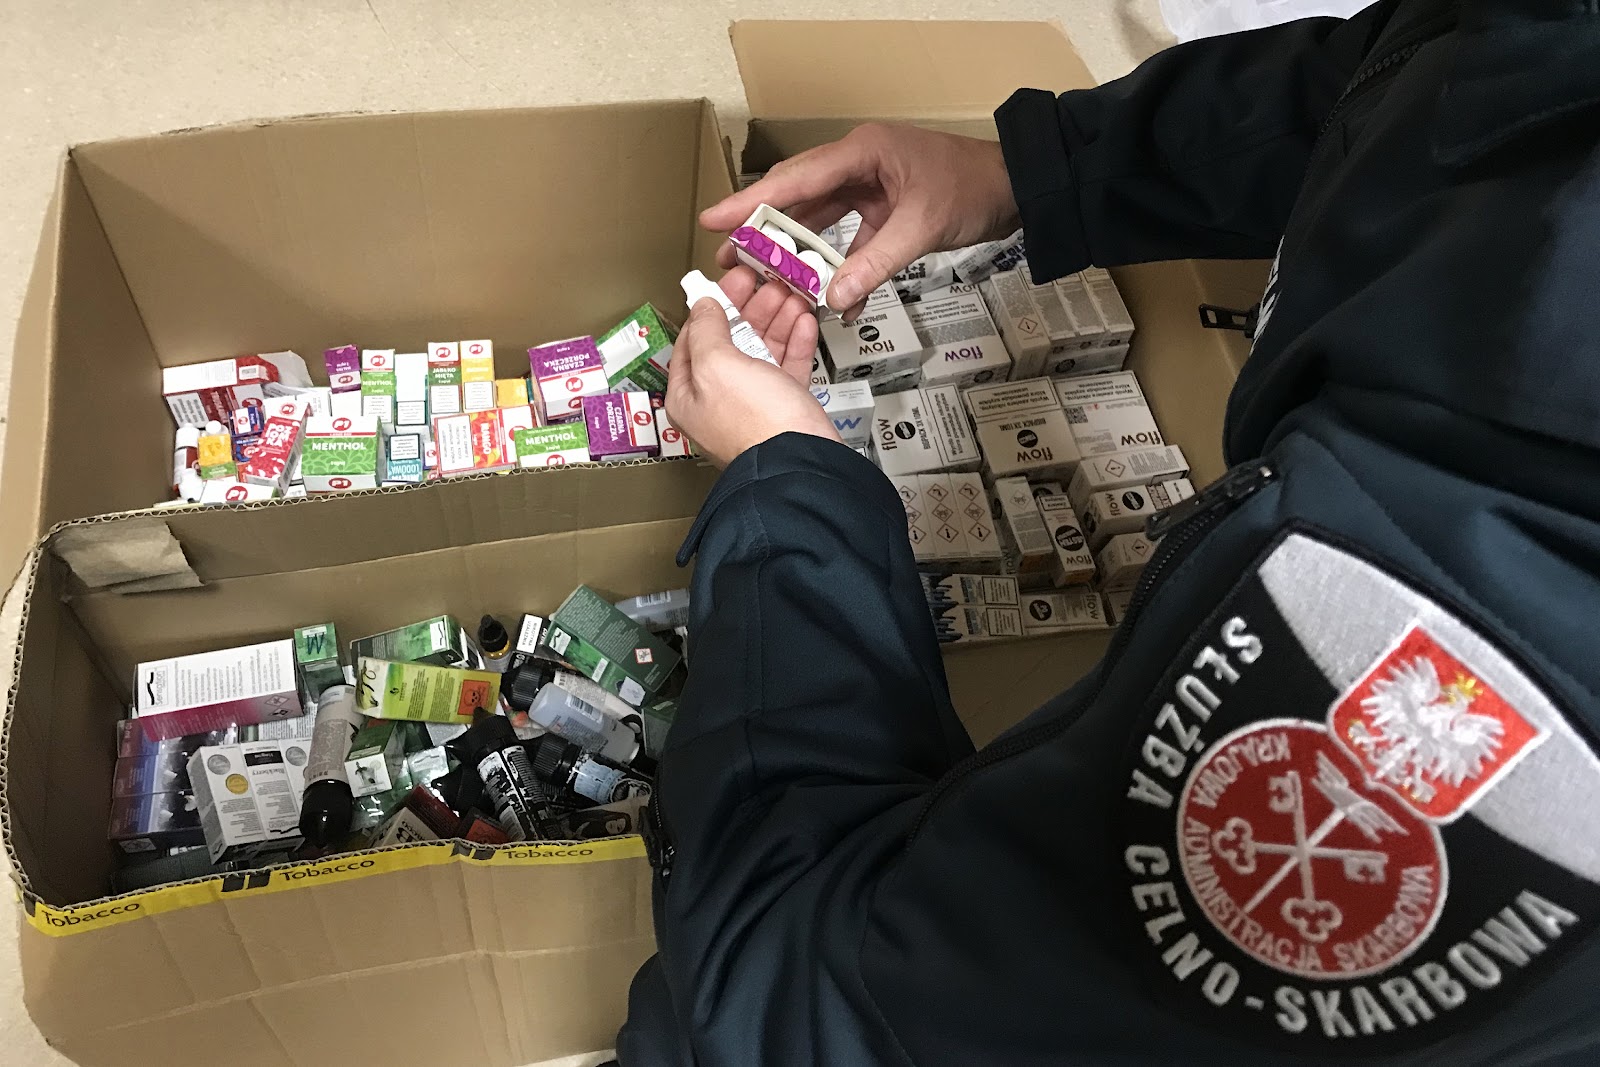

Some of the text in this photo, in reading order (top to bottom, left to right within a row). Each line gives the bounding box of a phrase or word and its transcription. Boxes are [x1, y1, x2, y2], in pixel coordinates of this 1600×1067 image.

[859, 339, 895, 356] flow
[945, 346, 984, 362] flow
[543, 352, 590, 367] PORZECZKA
[553, 360, 584, 372] CZARNA
[639, 370, 665, 391] MENTHO
[605, 401, 618, 441] PORZECZKA
[614, 406, 625, 434] CZARNA
[481, 423, 491, 455] MANGO
[525, 431, 578, 446] MENTHOL
[878, 418, 897, 451] flow
[1121, 431, 1161, 446] flow
[312, 442, 367, 451] MENTHOL
[1017, 447, 1053, 462] flow
[1105, 493, 1122, 516] flow
[1066, 554, 1092, 565] flow
[1086, 594, 1099, 620] flow
[155, 670, 163, 706] Sensation
[1126, 615, 1263, 809] SŁUŻBA
[252, 767, 285, 776] Blackberry
[268, 819, 299, 829] ensation
[504, 847, 594, 860] Tobacco
[1185, 733, 1434, 972] KRAJOWA ADMINISTRACJA SKARBOWA
[279, 858, 376, 882] Tobacco
[41, 900, 140, 928] Tobacco
